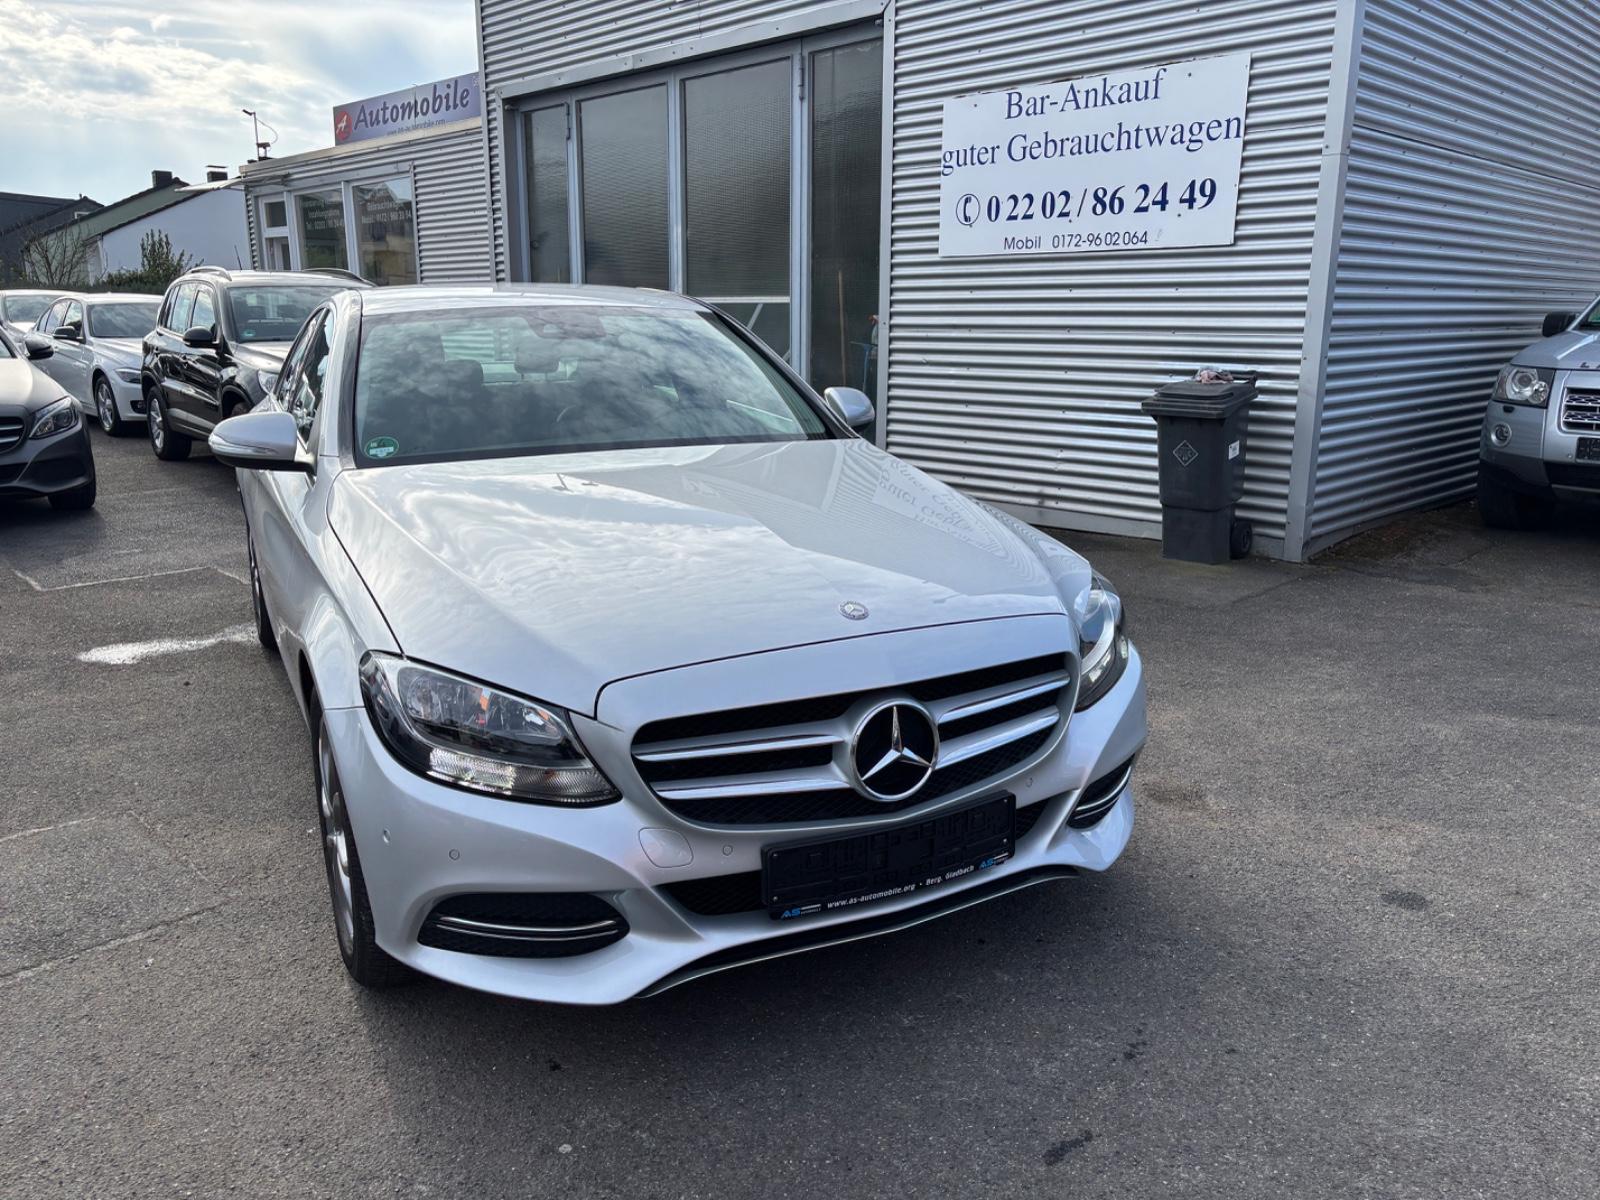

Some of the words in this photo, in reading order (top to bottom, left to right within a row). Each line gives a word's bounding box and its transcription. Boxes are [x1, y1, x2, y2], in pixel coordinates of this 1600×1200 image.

[353, 79, 471, 130] Automobile
[1005, 68, 1167, 120] Bar-Ankauf
[941, 144, 1000, 176] guter
[1007, 115, 1242, 162] Gebrauchtwagen
[1003, 236, 1042, 250] Mobil
[827, 883, 916, 909] www.as-automobile.org
[944, 864, 975, 880] Gladbach
